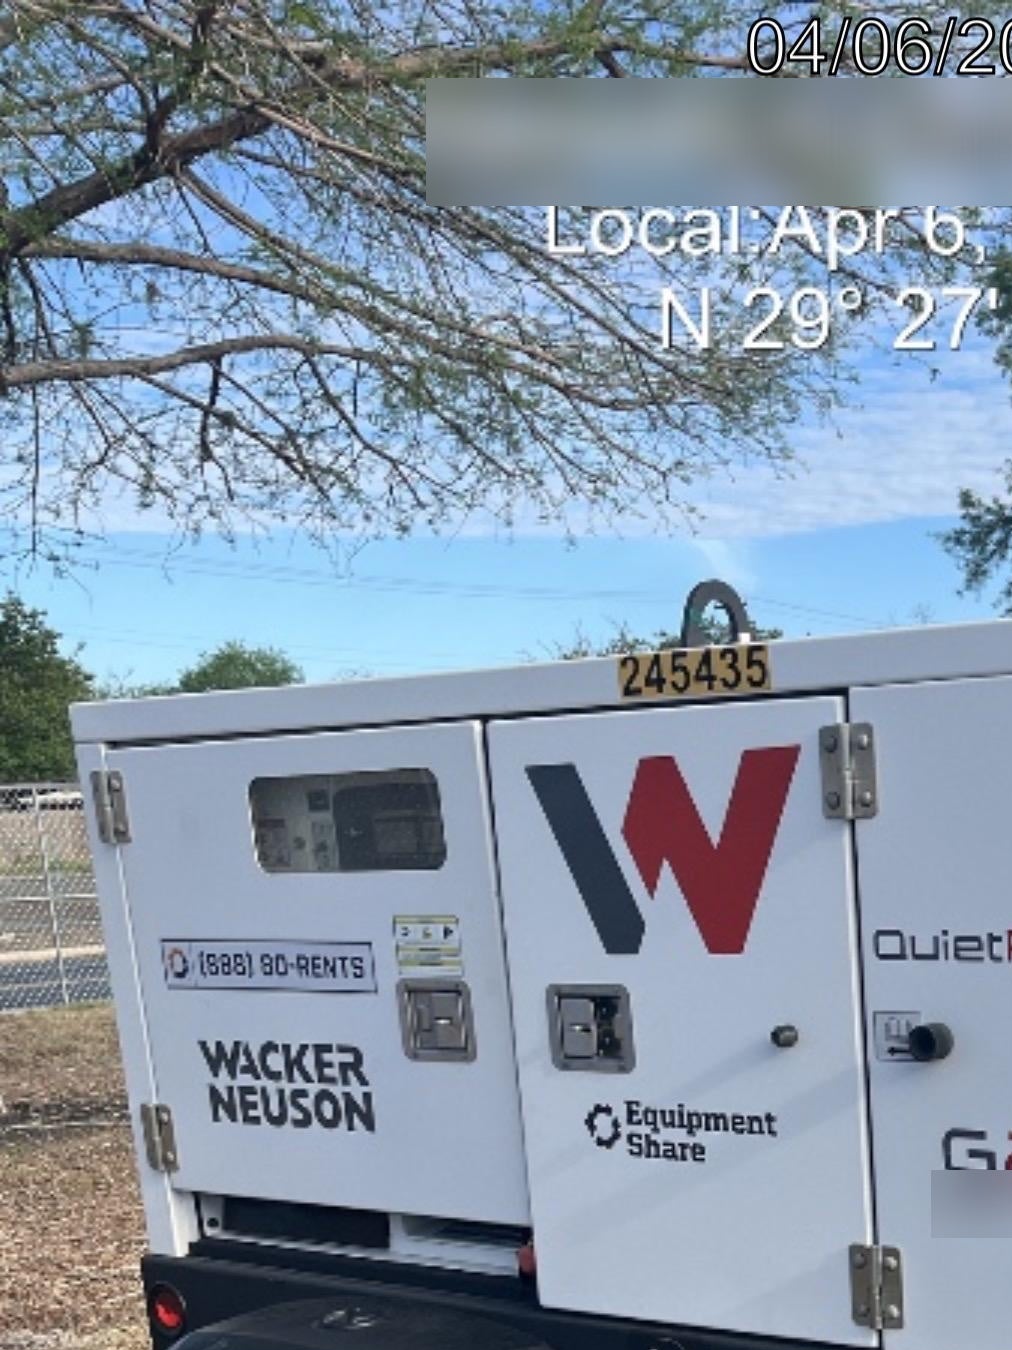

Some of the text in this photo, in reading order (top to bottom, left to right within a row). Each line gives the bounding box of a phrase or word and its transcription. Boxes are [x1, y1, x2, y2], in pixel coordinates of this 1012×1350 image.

[620, 645, 767, 697] 245435
[199, 949, 253, 979] (888)
[197, 1040, 370, 1087] WACKER
[207, 1083, 376, 1134] NEUSON
[624, 1100, 778, 1138] Equipment
[626, 1133, 706, 1163] Share
